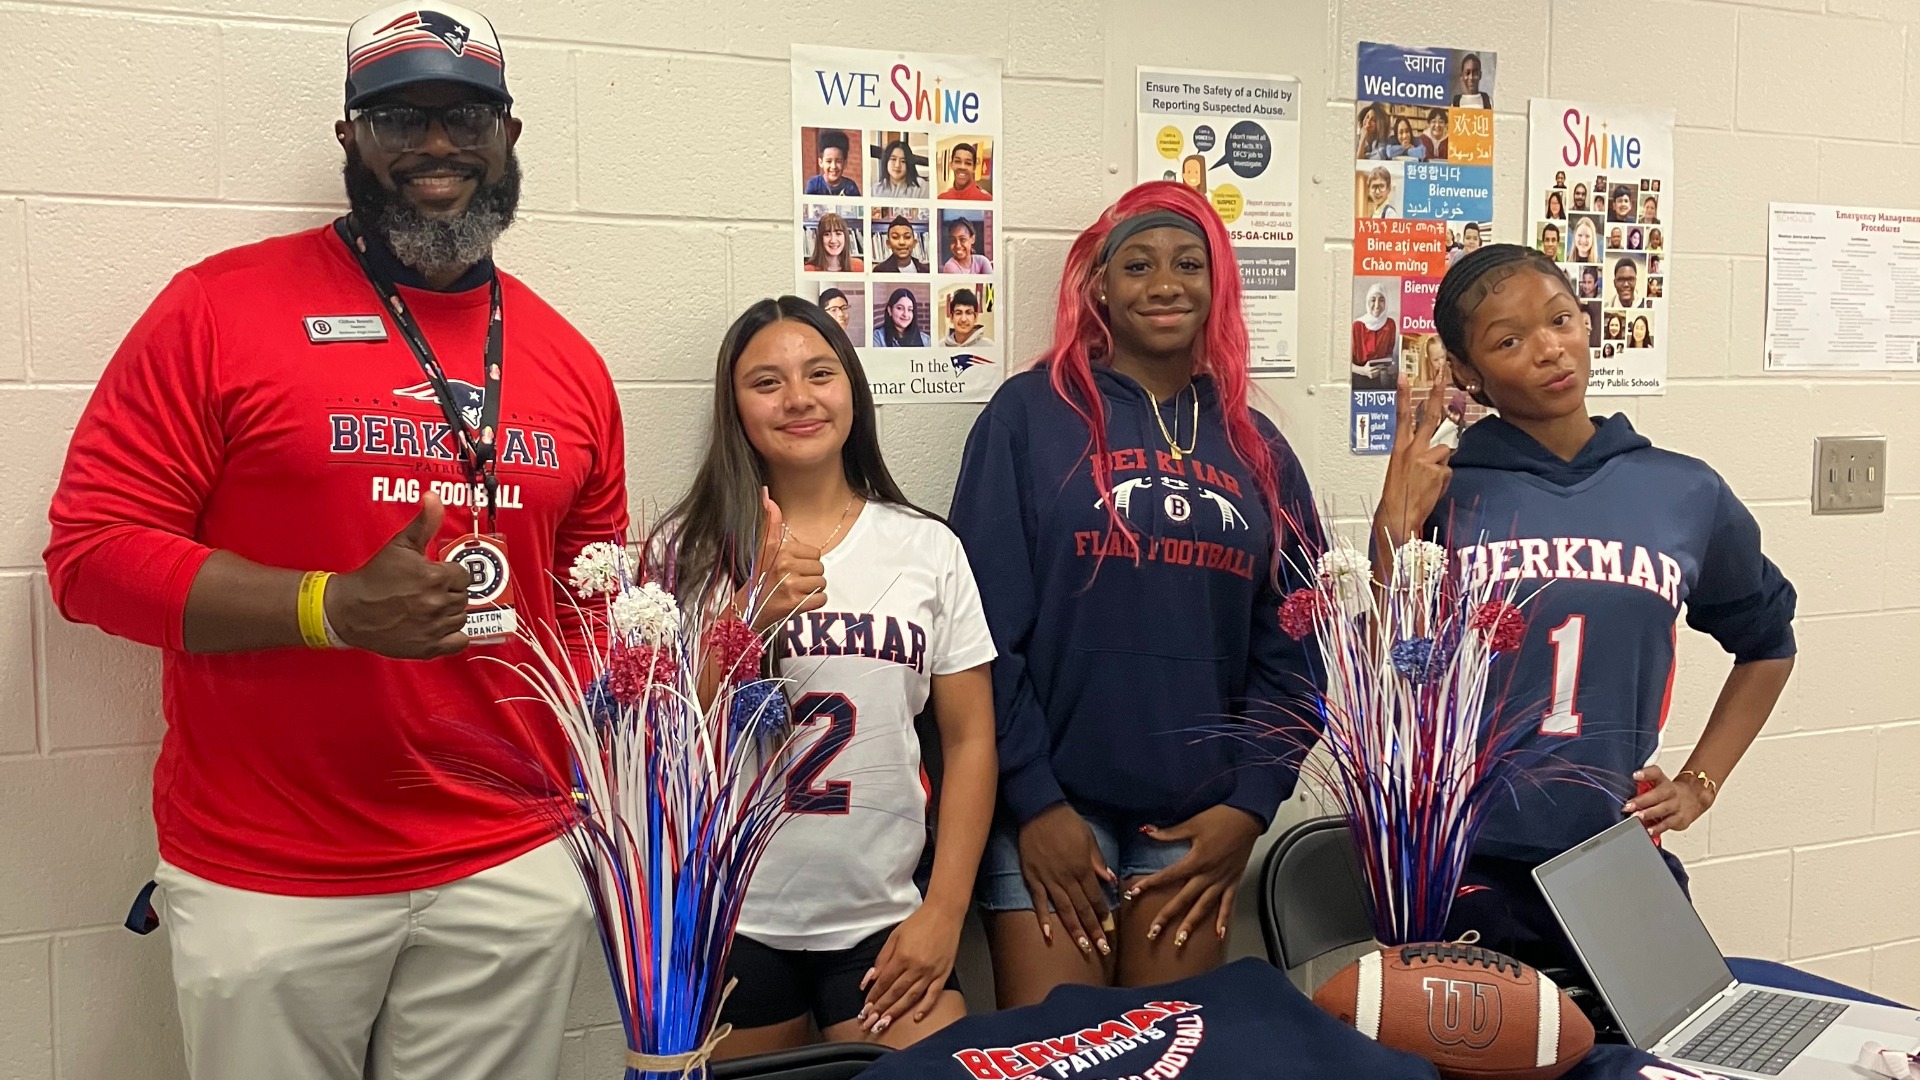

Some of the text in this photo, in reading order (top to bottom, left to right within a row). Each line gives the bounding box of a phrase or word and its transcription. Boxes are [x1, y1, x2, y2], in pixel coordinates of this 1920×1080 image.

[1403, 54, 1446, 74] स्वागत
[815, 63, 979, 124] WE Shine
[1146, 81, 1292, 102] Ensure The Safety of a Child by
[1364, 75, 1444, 100] Welcome
[1152, 99, 1286, 116] Reporting Suspected Abuse.
[1453, 113, 1489, 137] 欢迎
[1562, 108, 1641, 169] Shine
[1407, 164, 1461, 181] 환영합니다
[1429, 183, 1488, 198] Bienvenue
[1246, 199, 1263, 207] Report
[1836, 210, 1877, 223] Emergency
[1861, 223, 1901, 233] Procedures
[1367, 237, 1393, 252] Bine
[1413, 240, 1442, 253] venit
[1362, 257, 1393, 271] Chào
[910, 359, 949, 373] In the
[1617, 367, 1624, 376] in
[910, 378, 965, 394] Cluster
[1607, 378, 1629, 387] Public
[1631, 378, 1660, 387] Schools
[1370, 412, 1389, 420] We're
[1370, 422, 1386, 432] glad
[1370, 433, 1391, 442] you're
[372, 476, 420, 503] FLAG
[1170, 498, 1185, 517] B
[465, 558, 488, 587] B
[1458, 537, 1682, 610] BERKMAR
[468, 626, 503, 636] BRANCH
[1538, 614, 1586, 737] 1
[784, 692, 857, 814] 2
[1423, 977, 1501, 1048] W
[952, 1000, 1203, 1080] BERKMAR
[1143, 1014, 1204, 1080] FOOTBALL
[1051, 1027, 1166, 1078] PATRIOTS
